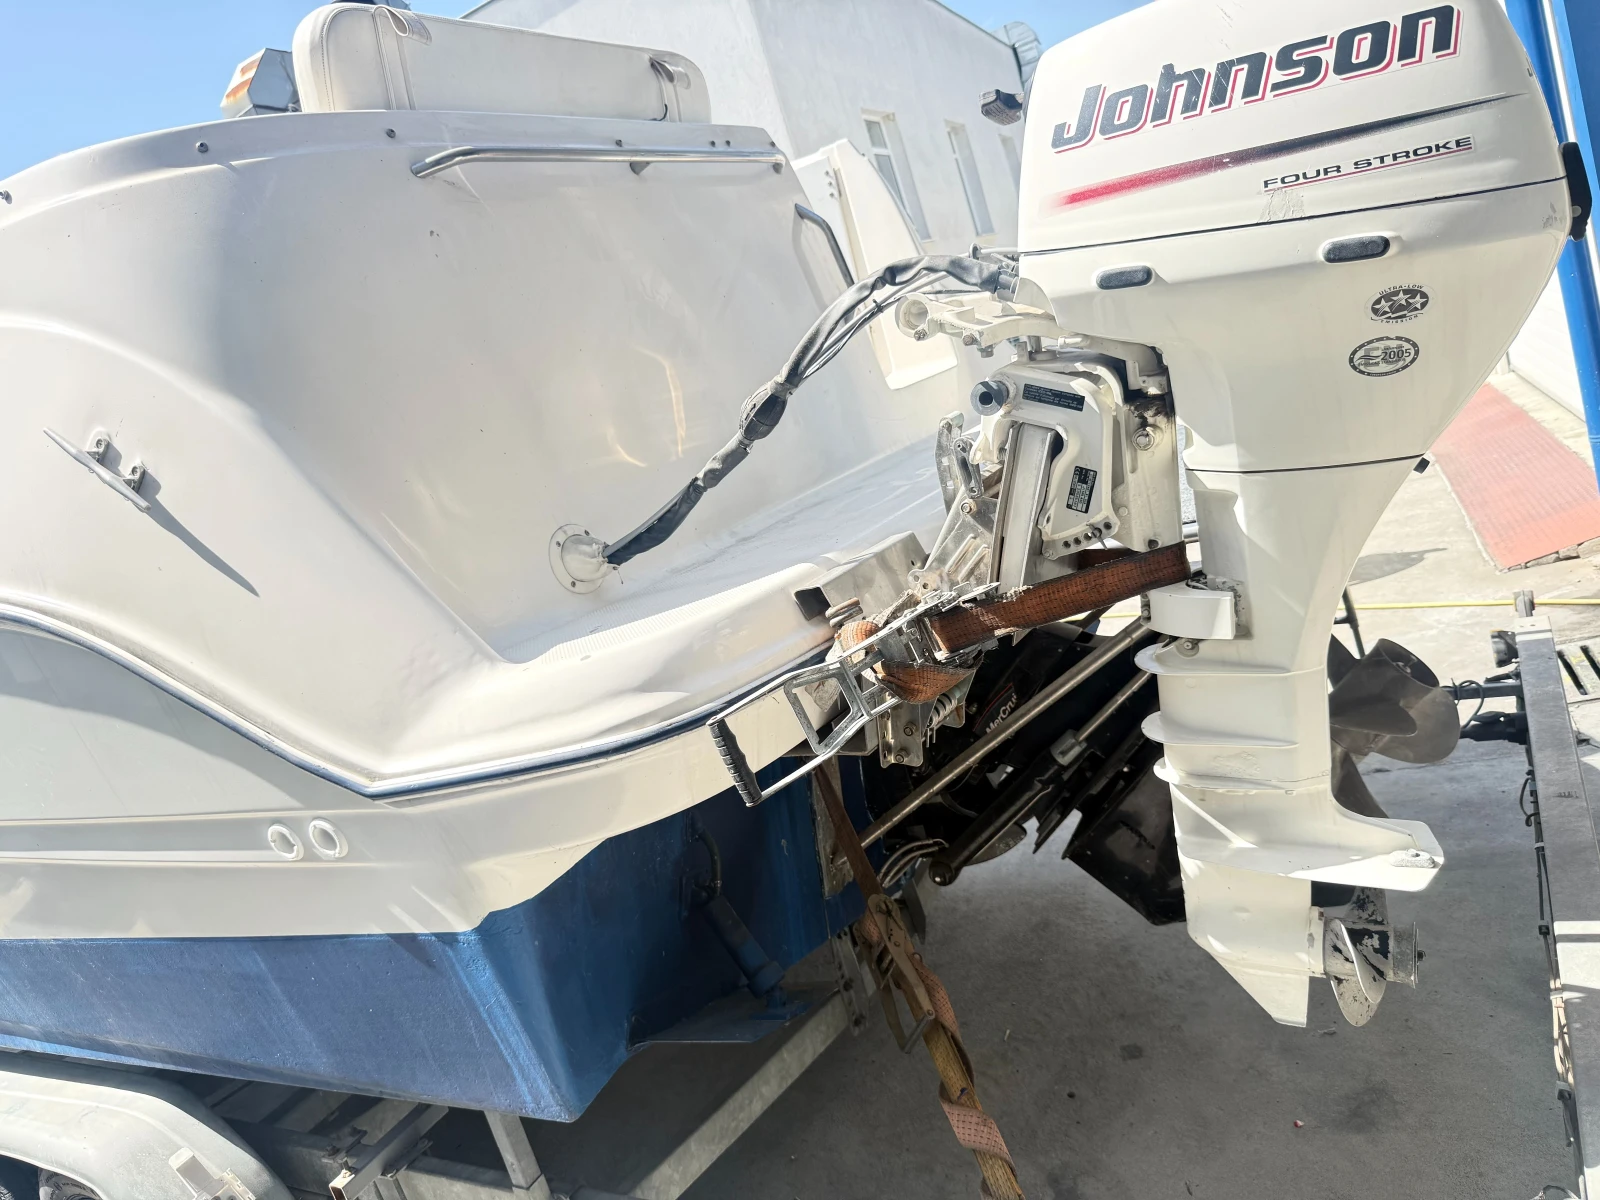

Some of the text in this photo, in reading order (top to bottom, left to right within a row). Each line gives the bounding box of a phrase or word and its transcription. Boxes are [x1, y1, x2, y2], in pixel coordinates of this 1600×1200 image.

[1051, 4, 1460, 152] Johnson
[1264, 136, 1473, 190] FOUR STROKE
[1378, 284, 1424, 296] ULTRA-LOW
[1381, 348, 1411, 361] 2005
